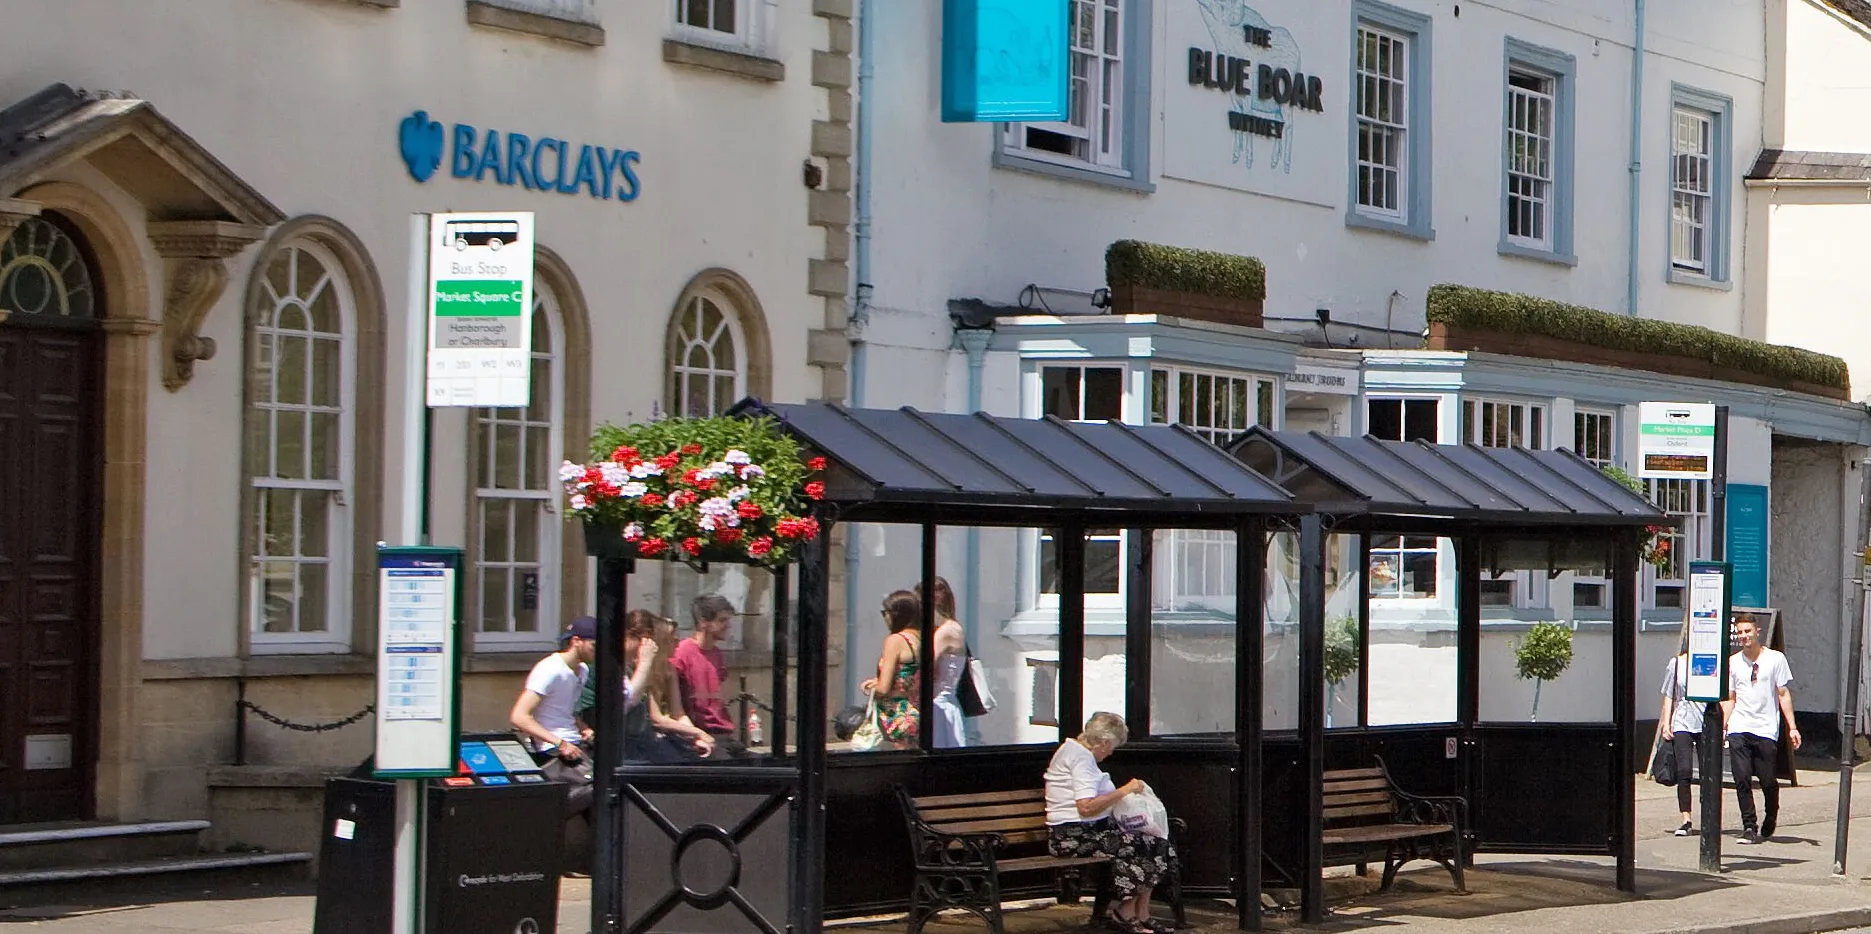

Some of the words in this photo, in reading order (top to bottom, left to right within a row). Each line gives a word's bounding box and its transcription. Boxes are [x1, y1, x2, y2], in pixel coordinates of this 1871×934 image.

[1243, 24, 1273, 49] THE
[1188, 47, 1251, 95] BLUE
[1257, 63, 1324, 113] BOAR
[451, 122, 642, 203] BARCLAYS
[451, 261, 473, 275] Bus
[478, 261, 508, 278] Stop
[435, 290, 472, 302] Market
[473, 290, 510, 305] Square
[511, 290, 522, 303] C
